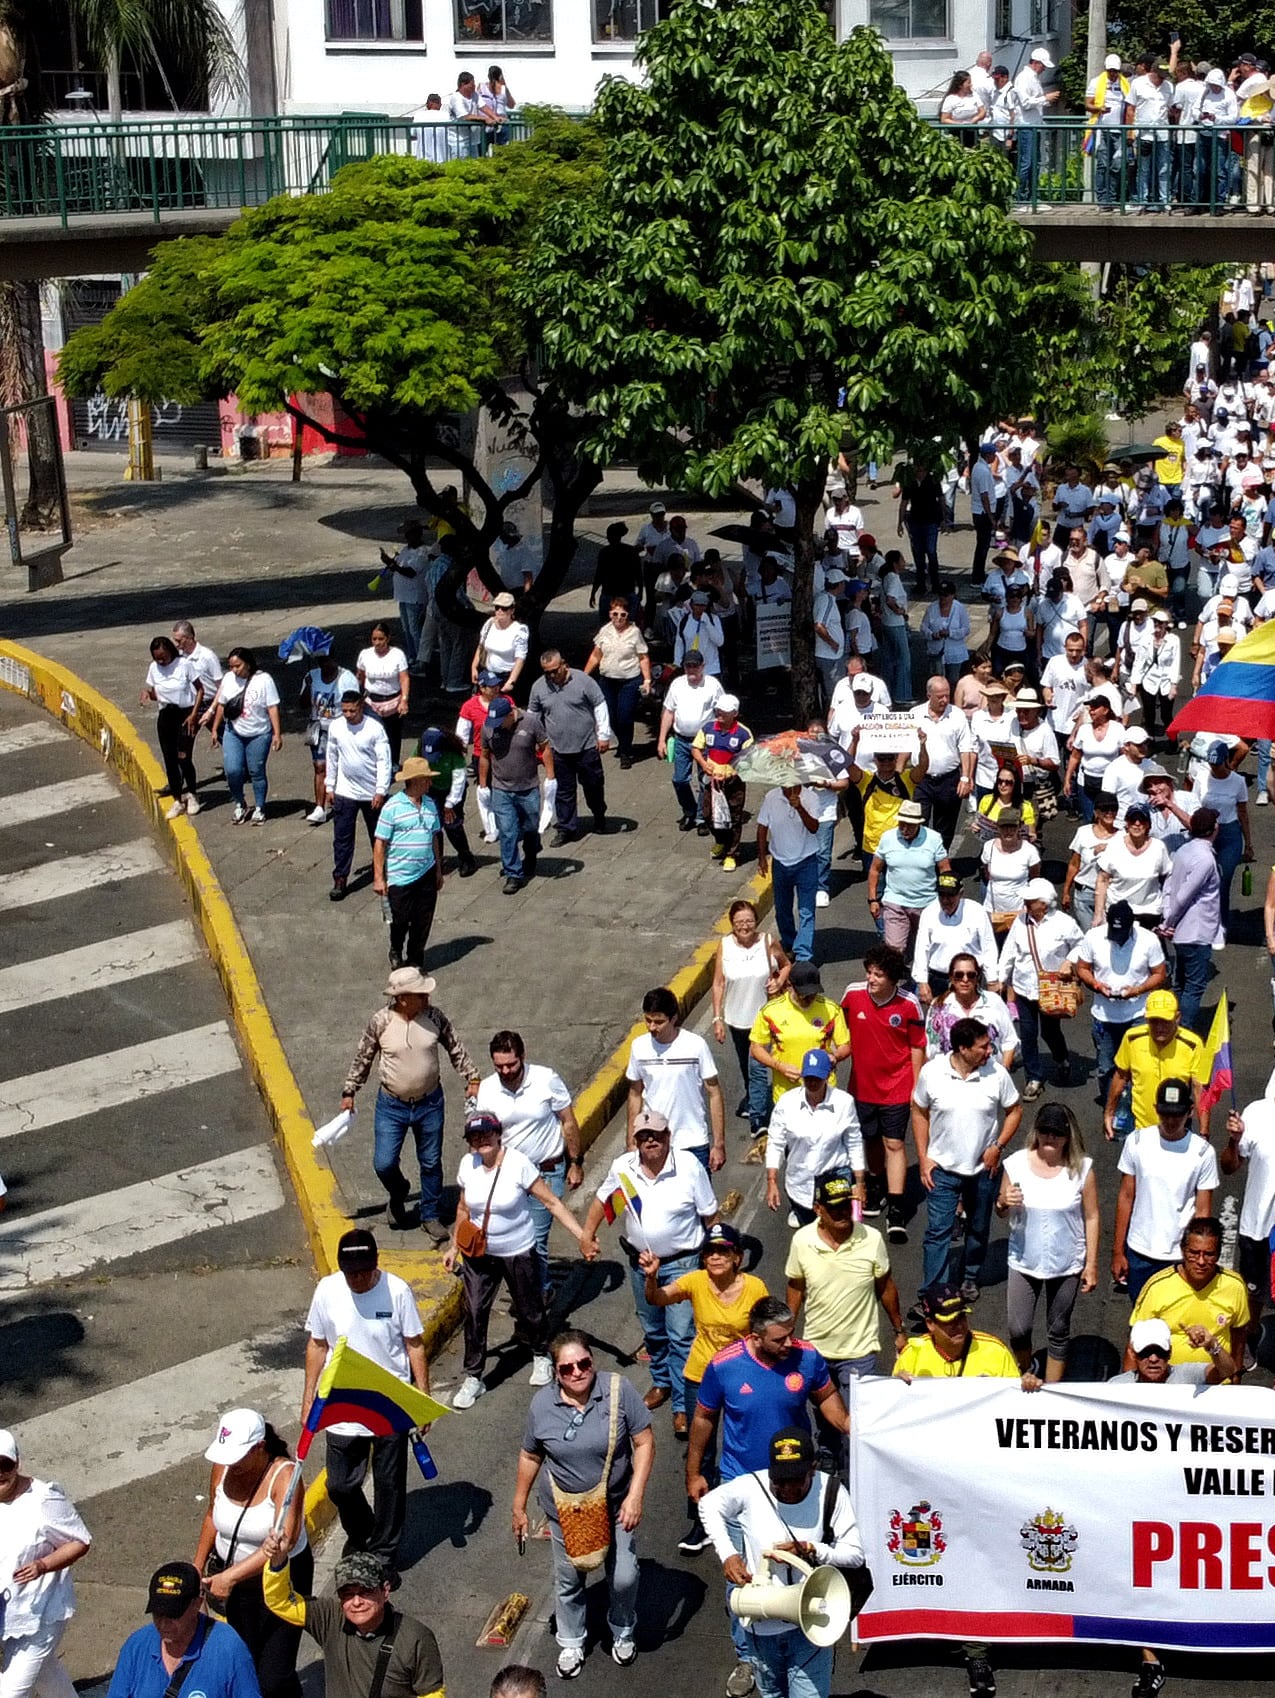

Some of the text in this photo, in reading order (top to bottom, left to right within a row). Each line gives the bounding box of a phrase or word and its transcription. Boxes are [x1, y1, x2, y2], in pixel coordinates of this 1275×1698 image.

[995, 1418, 1158, 1452] VETERANOS
[1164, 1423, 1183, 1452] Y
[1183, 1467, 1265, 1495] VALLE
[892, 1573, 944, 1587] EJÉRCITO
[1026, 1578, 1075, 1593] ARMADA
